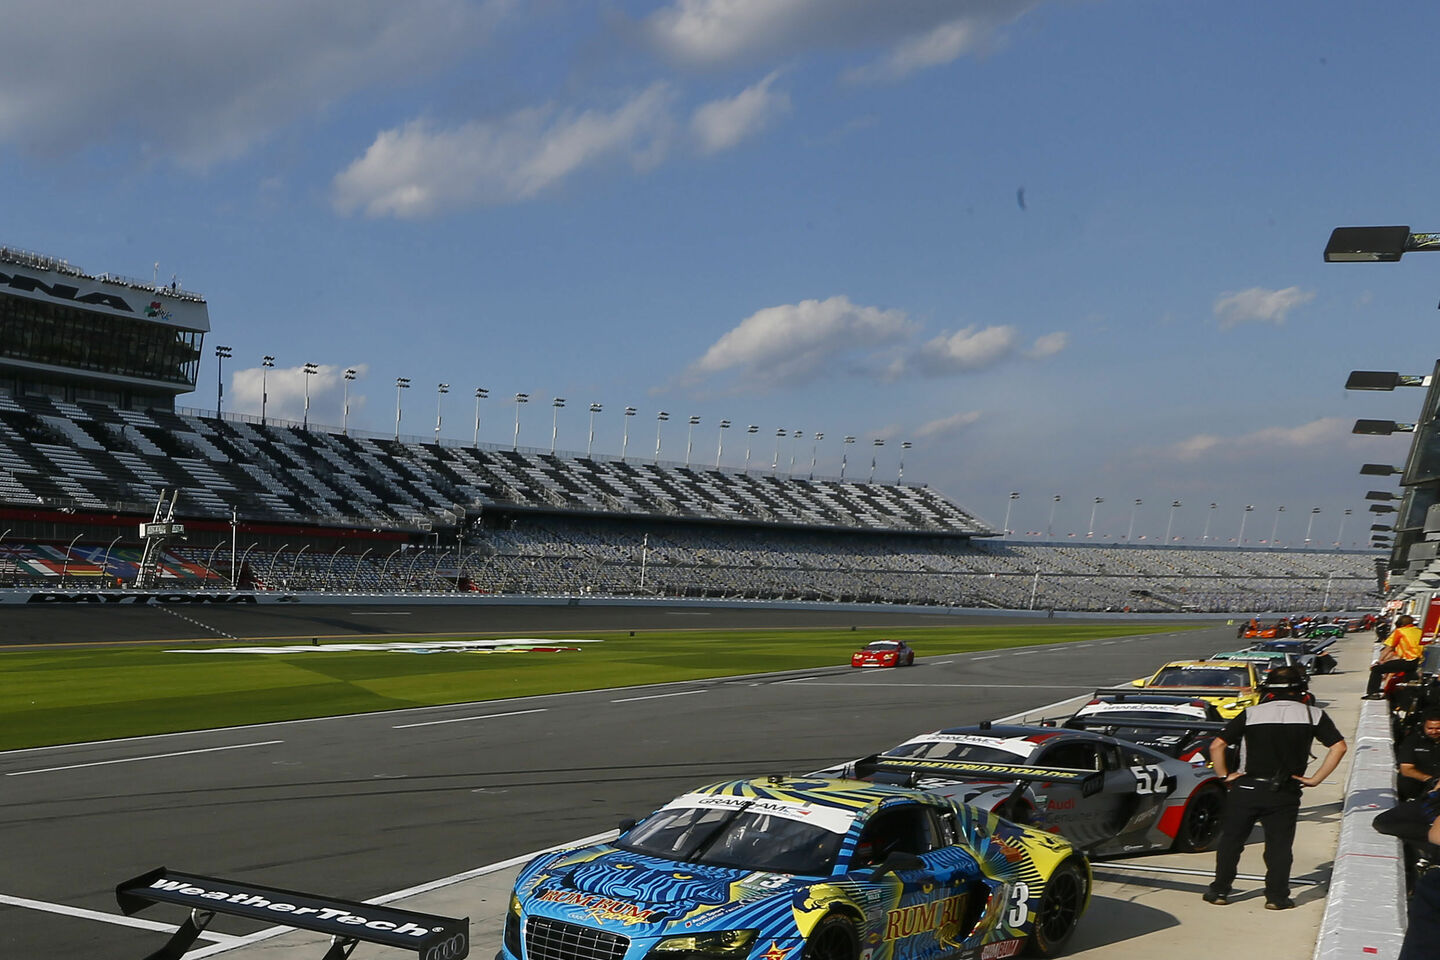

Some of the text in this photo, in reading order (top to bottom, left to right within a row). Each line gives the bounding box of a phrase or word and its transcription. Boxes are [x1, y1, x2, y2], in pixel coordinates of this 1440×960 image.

[27, 593, 258, 605] DAYTONA
[1130, 765, 1168, 795] 52
[1048, 799, 1076, 810] Audi
[743, 872, 790, 889] 13
[150, 878, 430, 938] WeatherTech
[541, 890, 653, 919] RUM RUM
[585, 907, 651, 926] Racing
[883, 904, 936, 940] RUM
